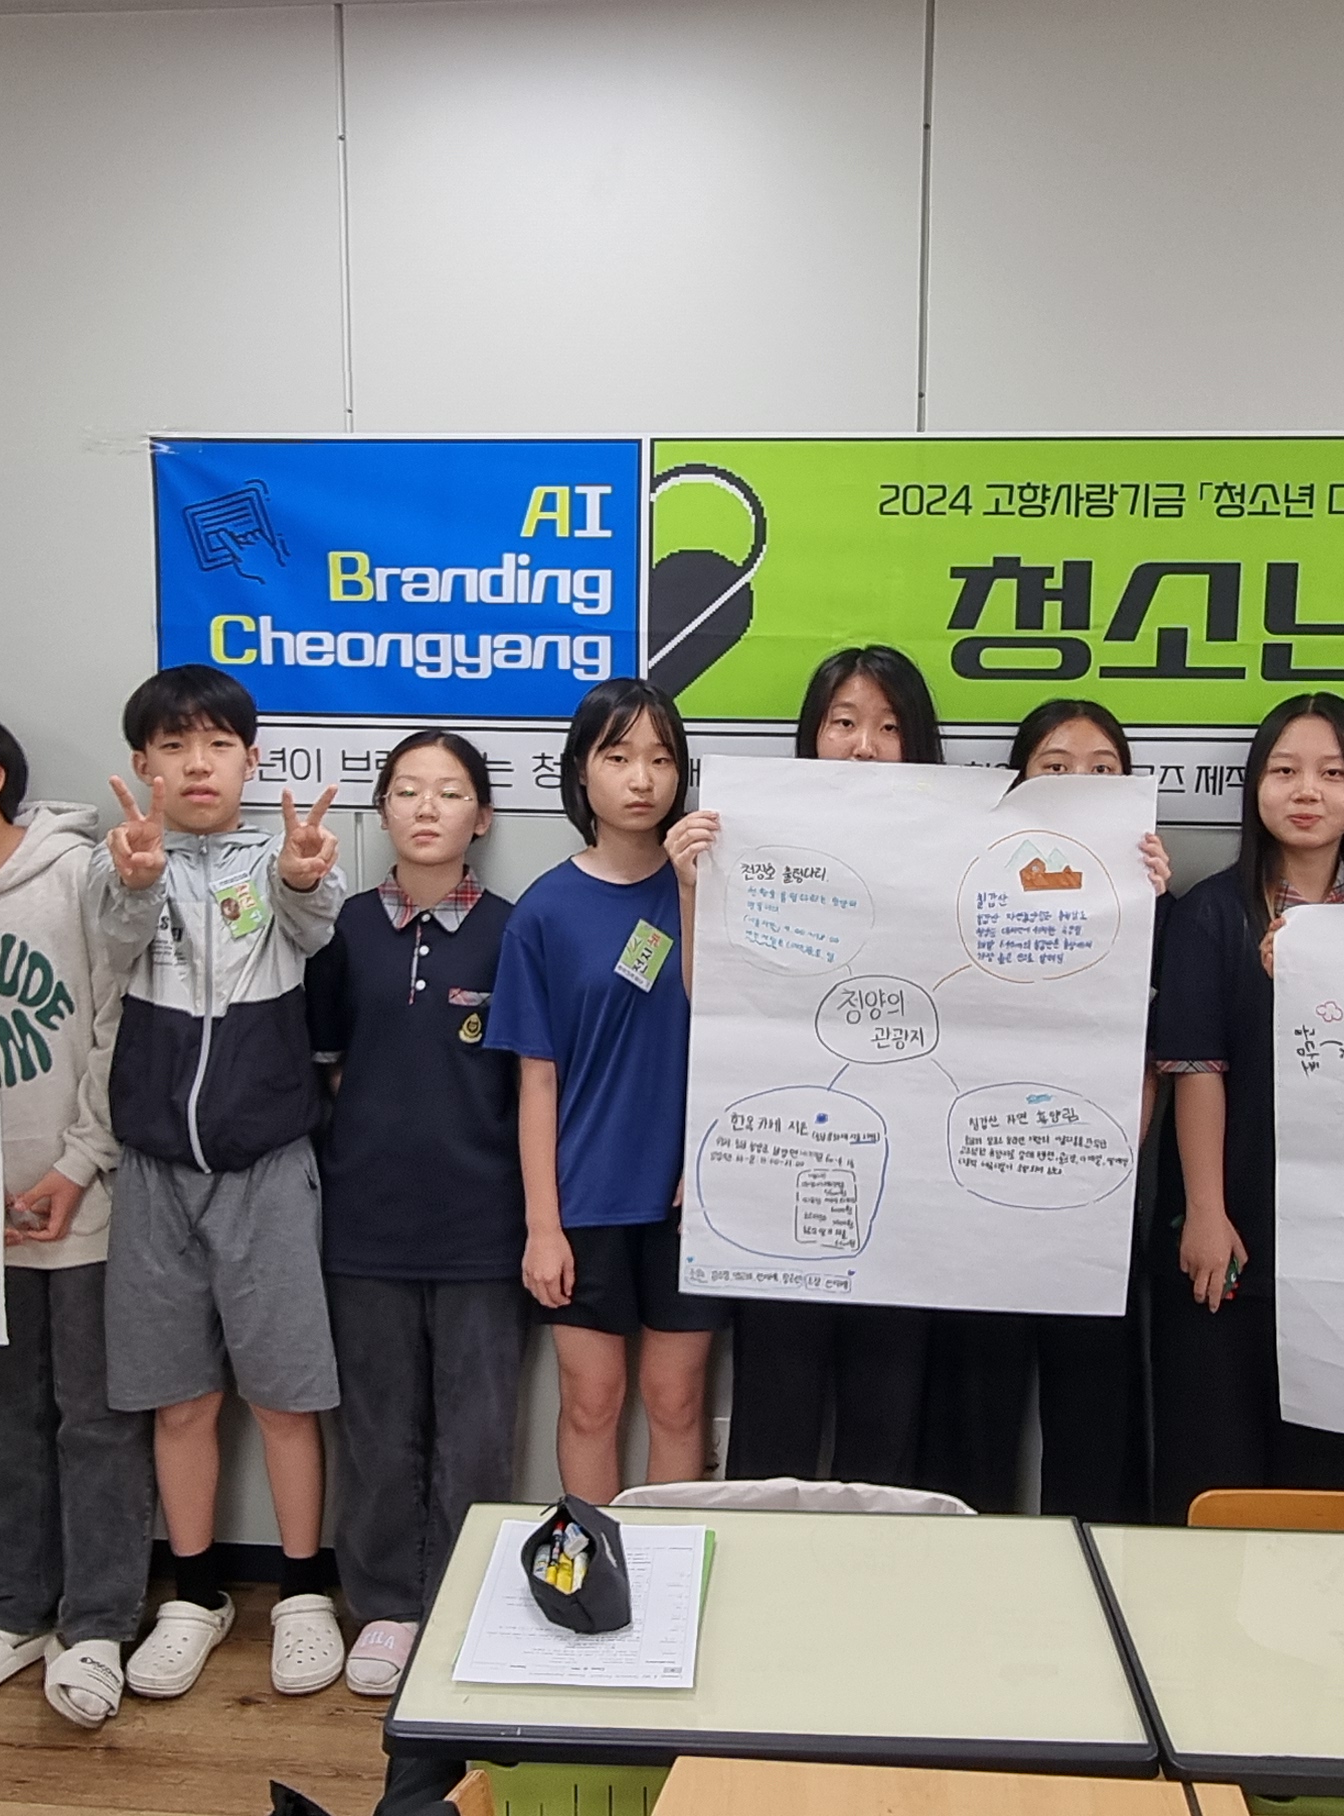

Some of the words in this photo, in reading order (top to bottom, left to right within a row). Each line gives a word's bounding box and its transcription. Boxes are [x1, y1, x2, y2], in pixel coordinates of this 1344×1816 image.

[521, 486, 612, 537] AI
[878, 484, 972, 517] 2024
[983, 482, 1186, 518] 고향사랑기금
[328, 551, 612, 615] Branding
[210, 614, 612, 681] Cheongyang
[837, 988, 906, 1025] 청양의
[870, 1026, 925, 1051] 관광지
